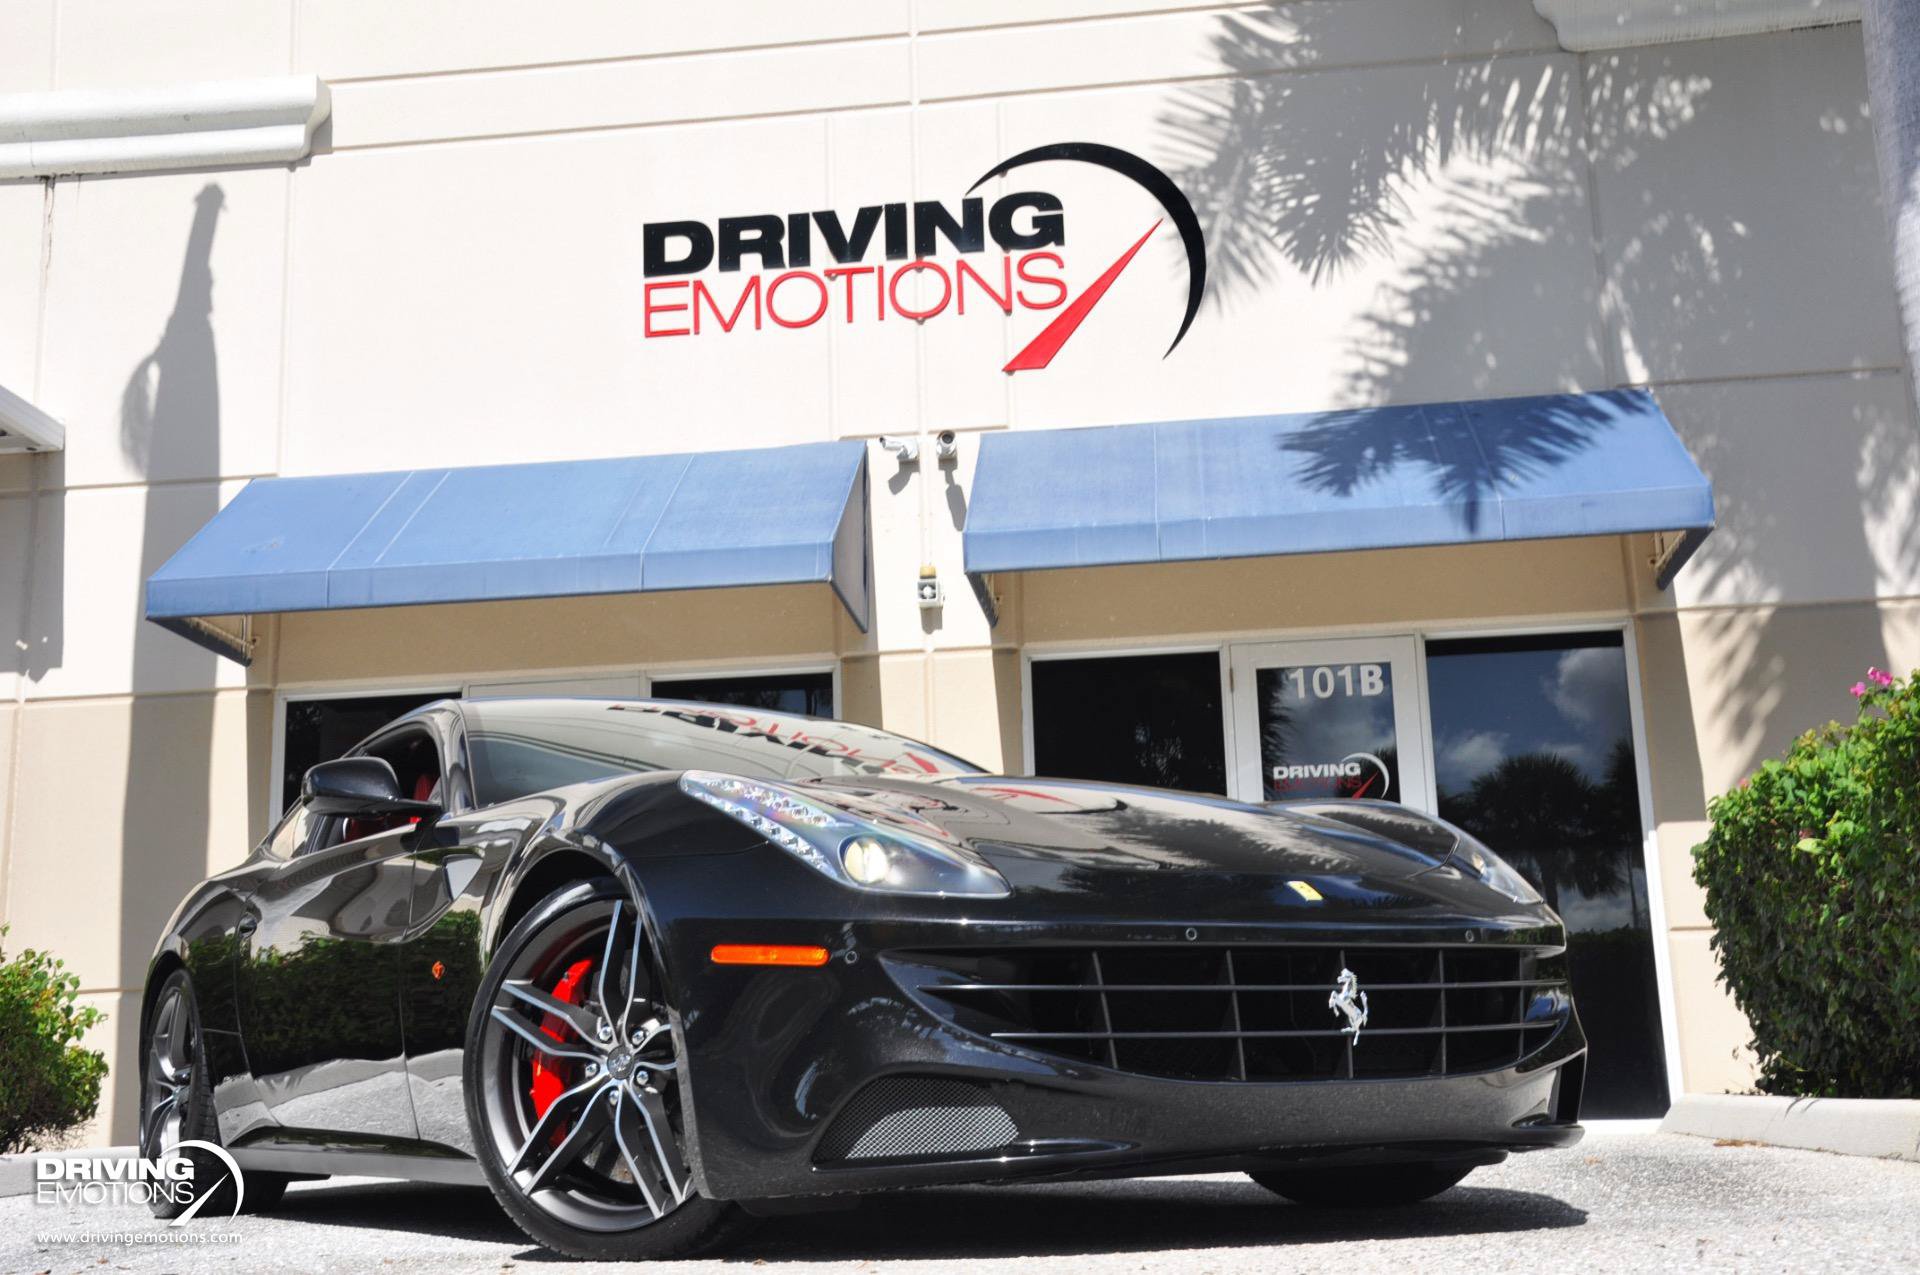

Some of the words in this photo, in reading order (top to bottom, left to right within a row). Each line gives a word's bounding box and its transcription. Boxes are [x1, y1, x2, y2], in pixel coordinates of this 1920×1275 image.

[643, 192, 1065, 278] DRIVING
[644, 252, 1067, 338] EMOTIONS
[1290, 664, 1384, 699] 101B
[1273, 763, 1361, 779] DRIVING
